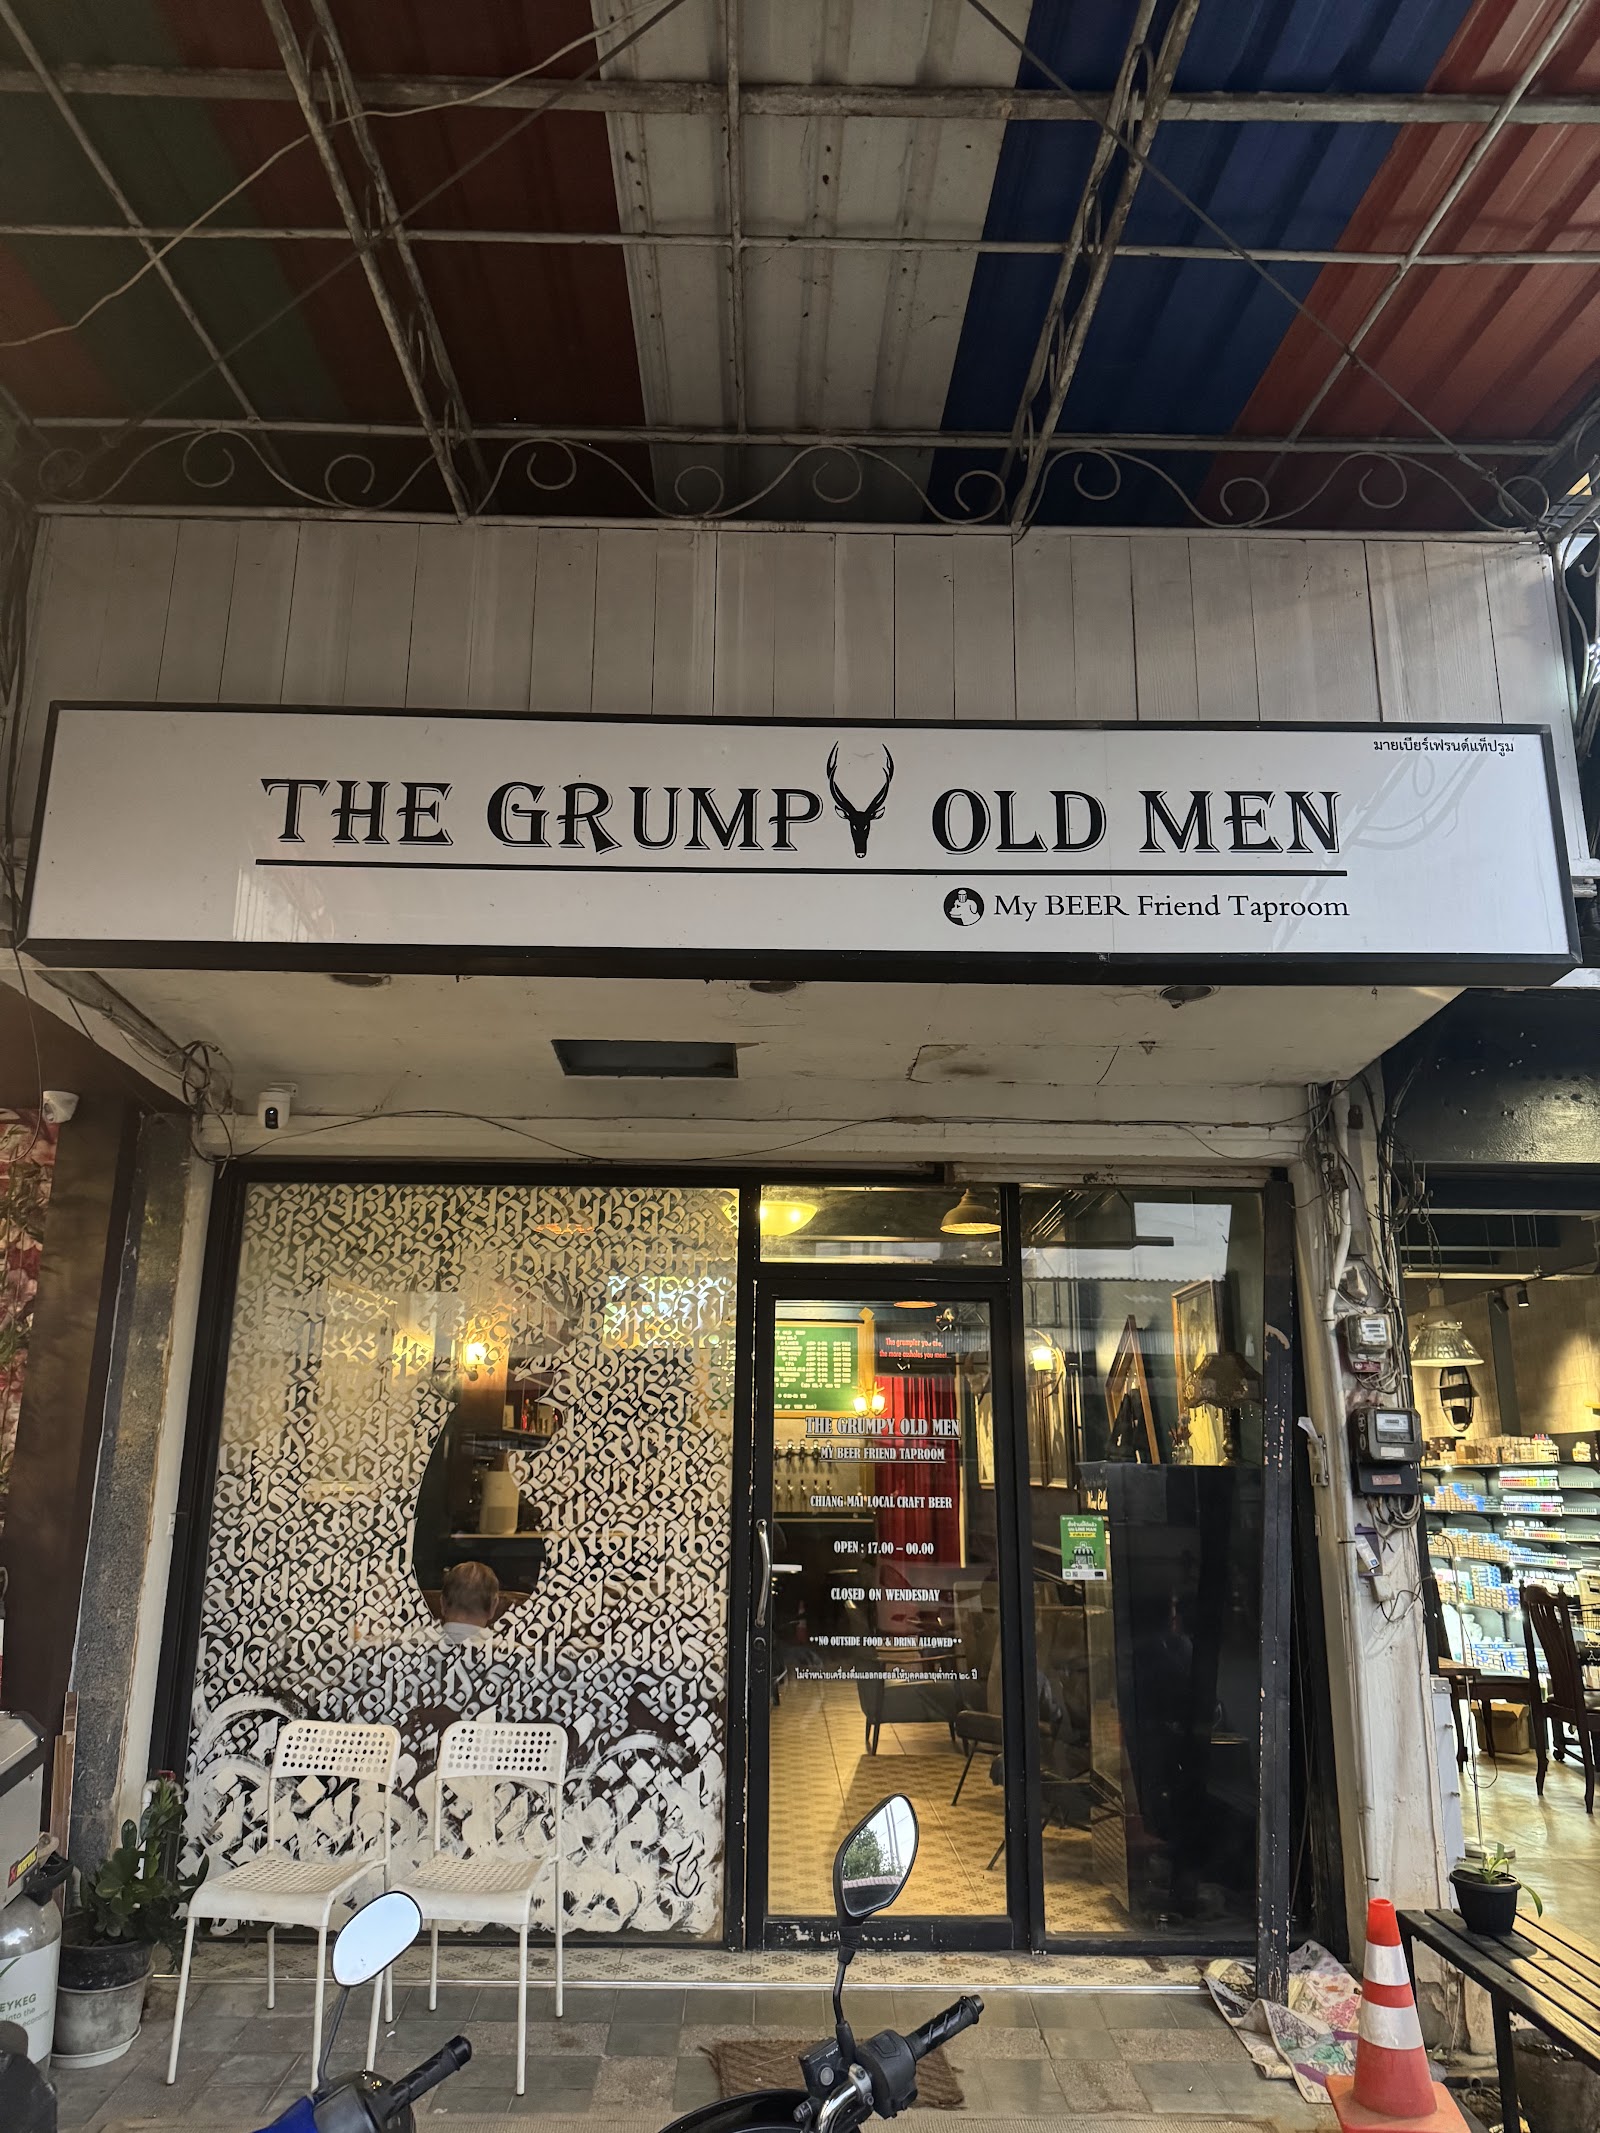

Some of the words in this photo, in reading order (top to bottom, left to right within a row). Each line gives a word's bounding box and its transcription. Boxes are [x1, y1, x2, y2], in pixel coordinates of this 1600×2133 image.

[1374, 736, 1514, 757] มายเบียร์เฟรนด์แท็ปรูม
[260, 777, 454, 848] THE
[931, 788, 1107, 856] OLD
[1138, 790, 1342, 854] MEN
[993, 895, 1038, 922] My
[1044, 895, 1130, 916] BEER
[1137, 894, 1221, 916] Friend
[1227, 895, 1350, 923] Taproom
[805, 1416, 833, 1434] THE
[837, 1417, 895, 1435] GRUMPY
[900, 1418, 928, 1436] OLD
[932, 1418, 960, 1436] MEN
[820, 1447, 833, 1460] MY
[837, 1447, 861, 1460] BEER
[864, 1447, 897, 1460] FRIEND
[900, 1448, 945, 1461] TAPROOM
[810, 1495, 844, 1508] CHIANG
[847, 1496, 864, 1508] MAI
[867, 1496, 896, 1508] LOCAL
[897, 1497, 926, 1509] CRAFT
[928, 1497, 952, 1509] BEER
[867, 1542, 894, 1554] 17.00
[905, 1543, 934, 1555] 00.00
[830, 1588, 865, 1600] CLOSED
[868, 1588, 882, 1601] ON
[885, 1589, 940, 1602] WENDESDAY
[830, 1636, 861, 1646] OUTSIDE
[863, 1637, 883, 1647] FOOD
[885, 1637, 892, 1647] &
[894, 1637, 917, 1647] DRINK
